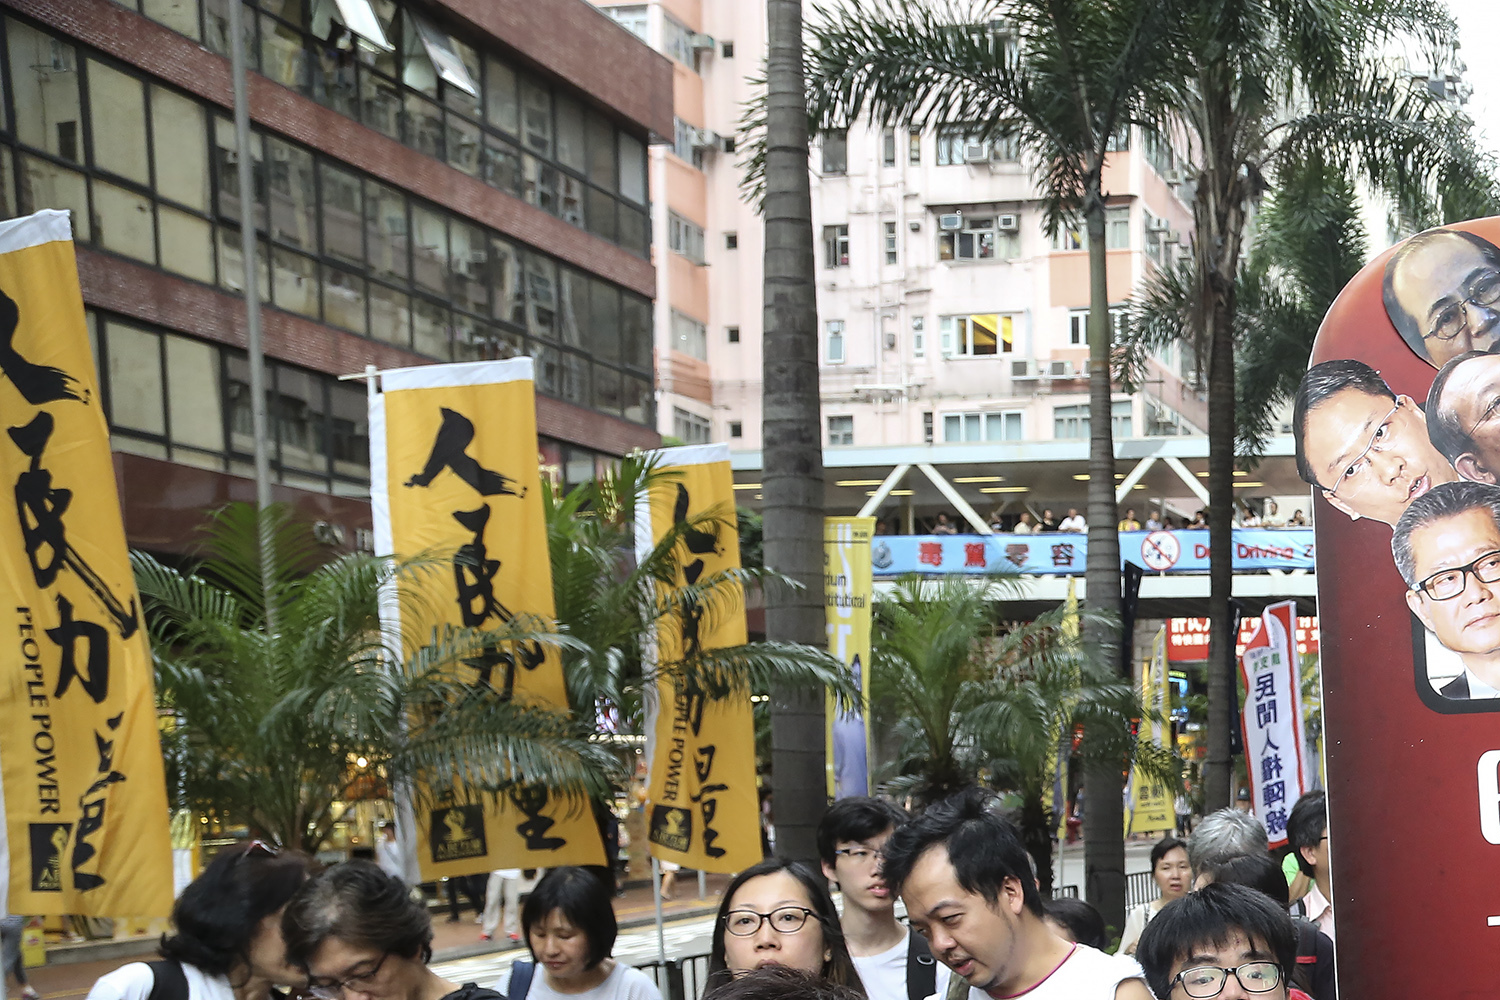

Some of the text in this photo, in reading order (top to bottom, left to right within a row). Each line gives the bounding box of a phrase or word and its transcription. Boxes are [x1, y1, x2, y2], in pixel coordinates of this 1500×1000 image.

[17, 607, 61, 814] PEOPLE POWER
[662, 738, 685, 801] POWER
